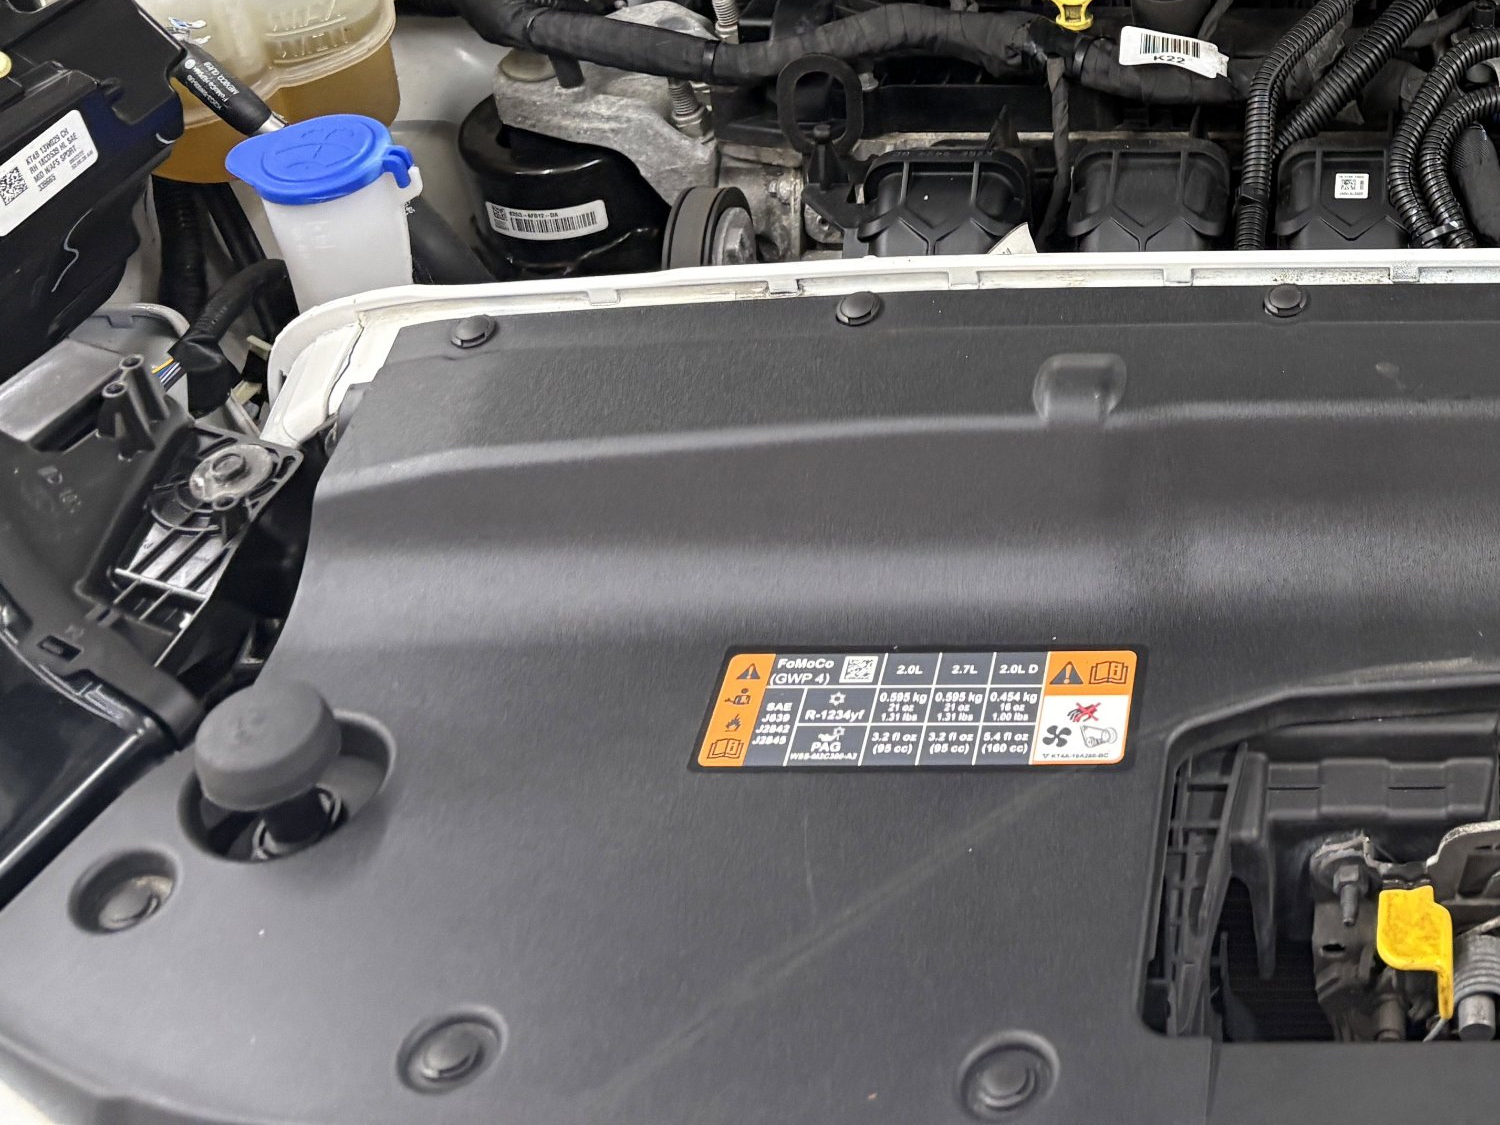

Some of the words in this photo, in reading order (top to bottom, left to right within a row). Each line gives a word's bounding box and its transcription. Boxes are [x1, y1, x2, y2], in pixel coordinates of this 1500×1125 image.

[1153, 55, 1186, 65] K22
[66, 132, 77, 144] SAE
[59, 144, 76, 162] SPORT
[778, 659, 834, 669] FoMoCo
[999, 664, 1026, 674] 2.0L
[1028, 664, 1038, 674] D
[896, 665, 923, 674] 2.0L
[952, 665, 978, 674] 2.7L
[770, 673, 812, 686] (GWP
[815, 673, 830, 686] 4)
[880, 692, 911, 702] 0.595
[912, 692, 928, 704] kg
[935, 692, 966, 702] 0.595
[968, 692, 982, 704] kg
[990, 692, 1020, 702] 0.454
[1022, 692, 1038, 704] kg
[766, 702, 792, 712] SAE
[888, 704, 900, 712] 21
[944, 704, 956, 712] 21
[1000, 704, 1011, 712] 16
[805, 710, 865, 722] R-1234yf
[881, 713, 900, 722] 1.31
[902, 713, 918, 722] lbs
[937, 713, 956, 722] 1.31
[958, 713, 974, 722] lbs
[992, 713, 1012, 722] 1.00
[1014, 713, 1029, 722] lbs
[872, 732, 890, 742] 3.2
[892, 732, 900, 742] fl
[902, 733, 917, 742] oz
[928, 732, 946, 742] 3.2
[948, 732, 956, 742] fl
[958, 733, 974, 742] oz
[984, 732, 1000, 742] 5.4
[1003, 732, 1012, 742] fl
[1014, 733, 1028, 742] oz
[810, 742, 842, 752] PAG
[872, 744, 892, 754] (95
[894, 744, 912, 754] cc)
[930, 744, 949, 754] (95
[950, 744, 970, 754] cc)
[1009, 744, 1028, 754] cc)
